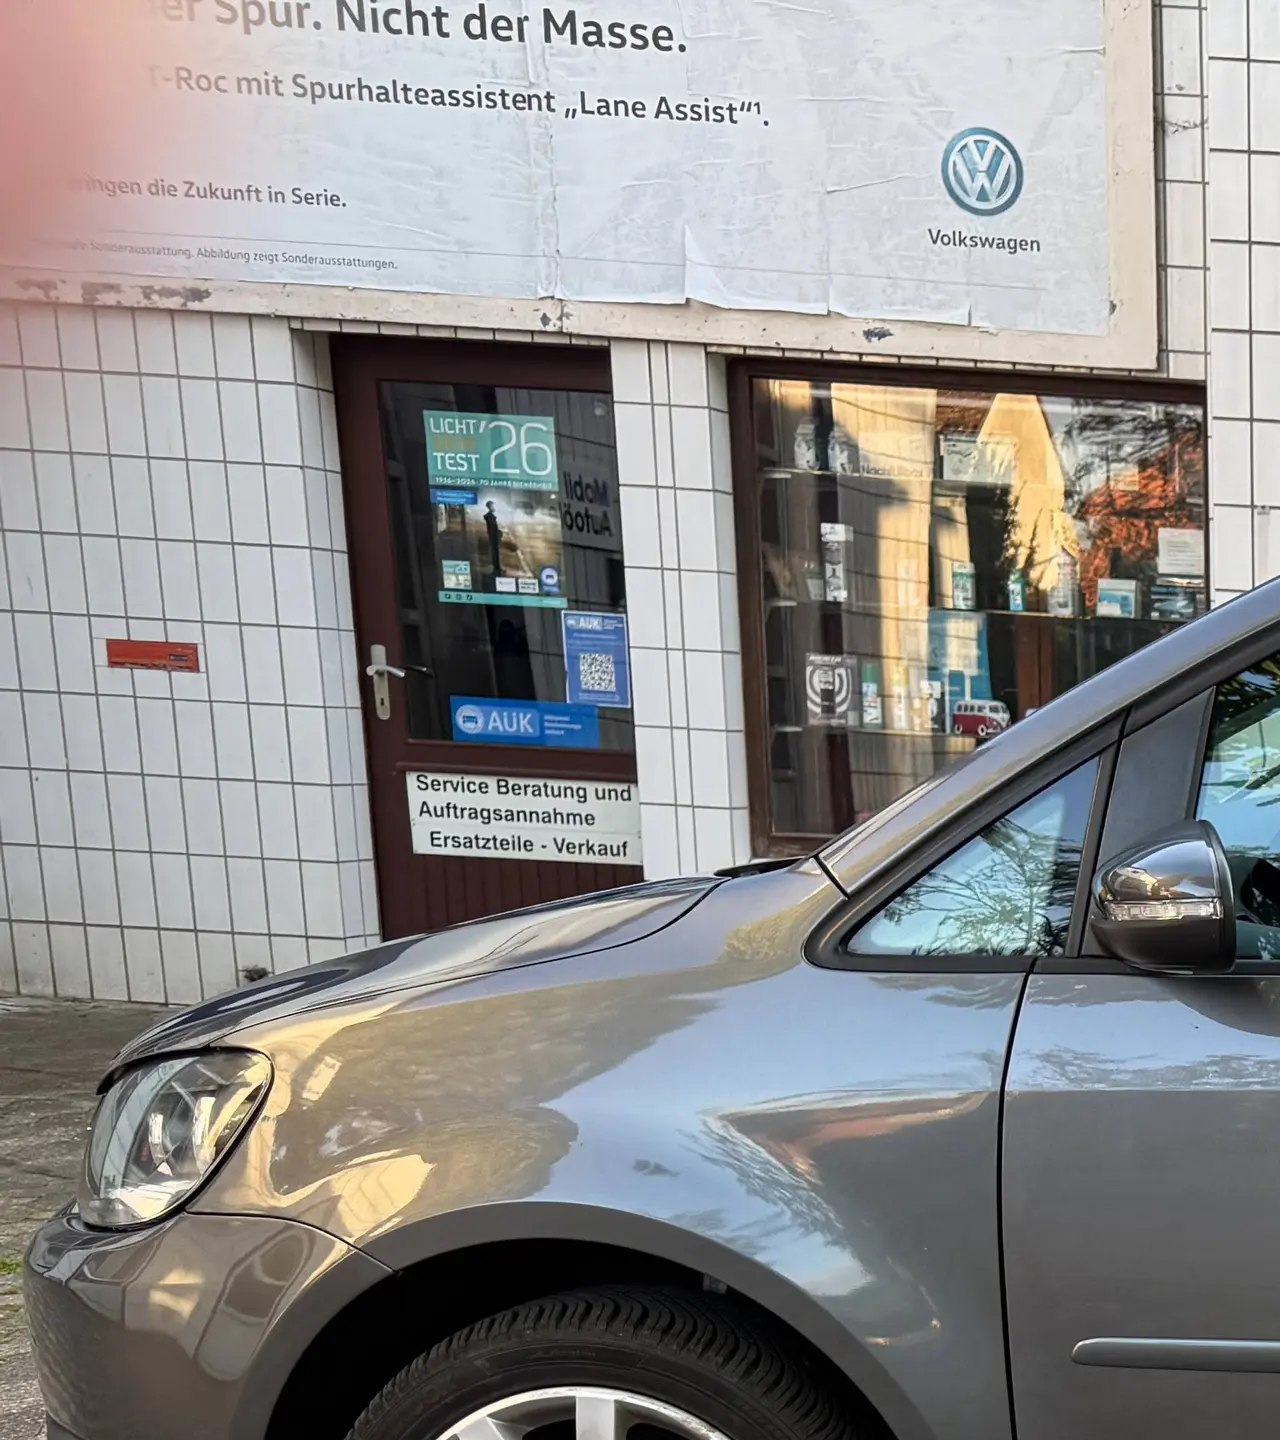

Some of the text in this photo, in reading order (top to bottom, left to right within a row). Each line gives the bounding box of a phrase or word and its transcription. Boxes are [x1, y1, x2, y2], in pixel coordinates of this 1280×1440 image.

[215, 0, 322, 35] Spur.
[337, 0, 450, 39] Nicht
[463, 3, 529, 43] der
[542, 8, 687, 52] Masse.
[236, 71, 284, 97] mit
[291, 73, 556, 113] Spurhalteassistent
[147, 178, 178, 198] die
[183, 180, 263, 203] Zukunft
[267, 185, 286, 204] in
[291, 187, 347, 208] Serie.
[928, 228, 1041, 254] Volkswagen
[196, 247, 251, 263] Abbildung
[252, 252, 280, 265] zeigt
[281, 252, 398, 270] Sonderausstattungen.
[429, 417, 477, 435] LICHT
[432, 452, 480, 472] TEST
[416, 774, 632, 803] Service Beratung und
[418, 801, 596, 826] Auftragsannahme
[430, 831, 534, 852] Ersatzteile
[553, 837, 629, 858] Verkauf
